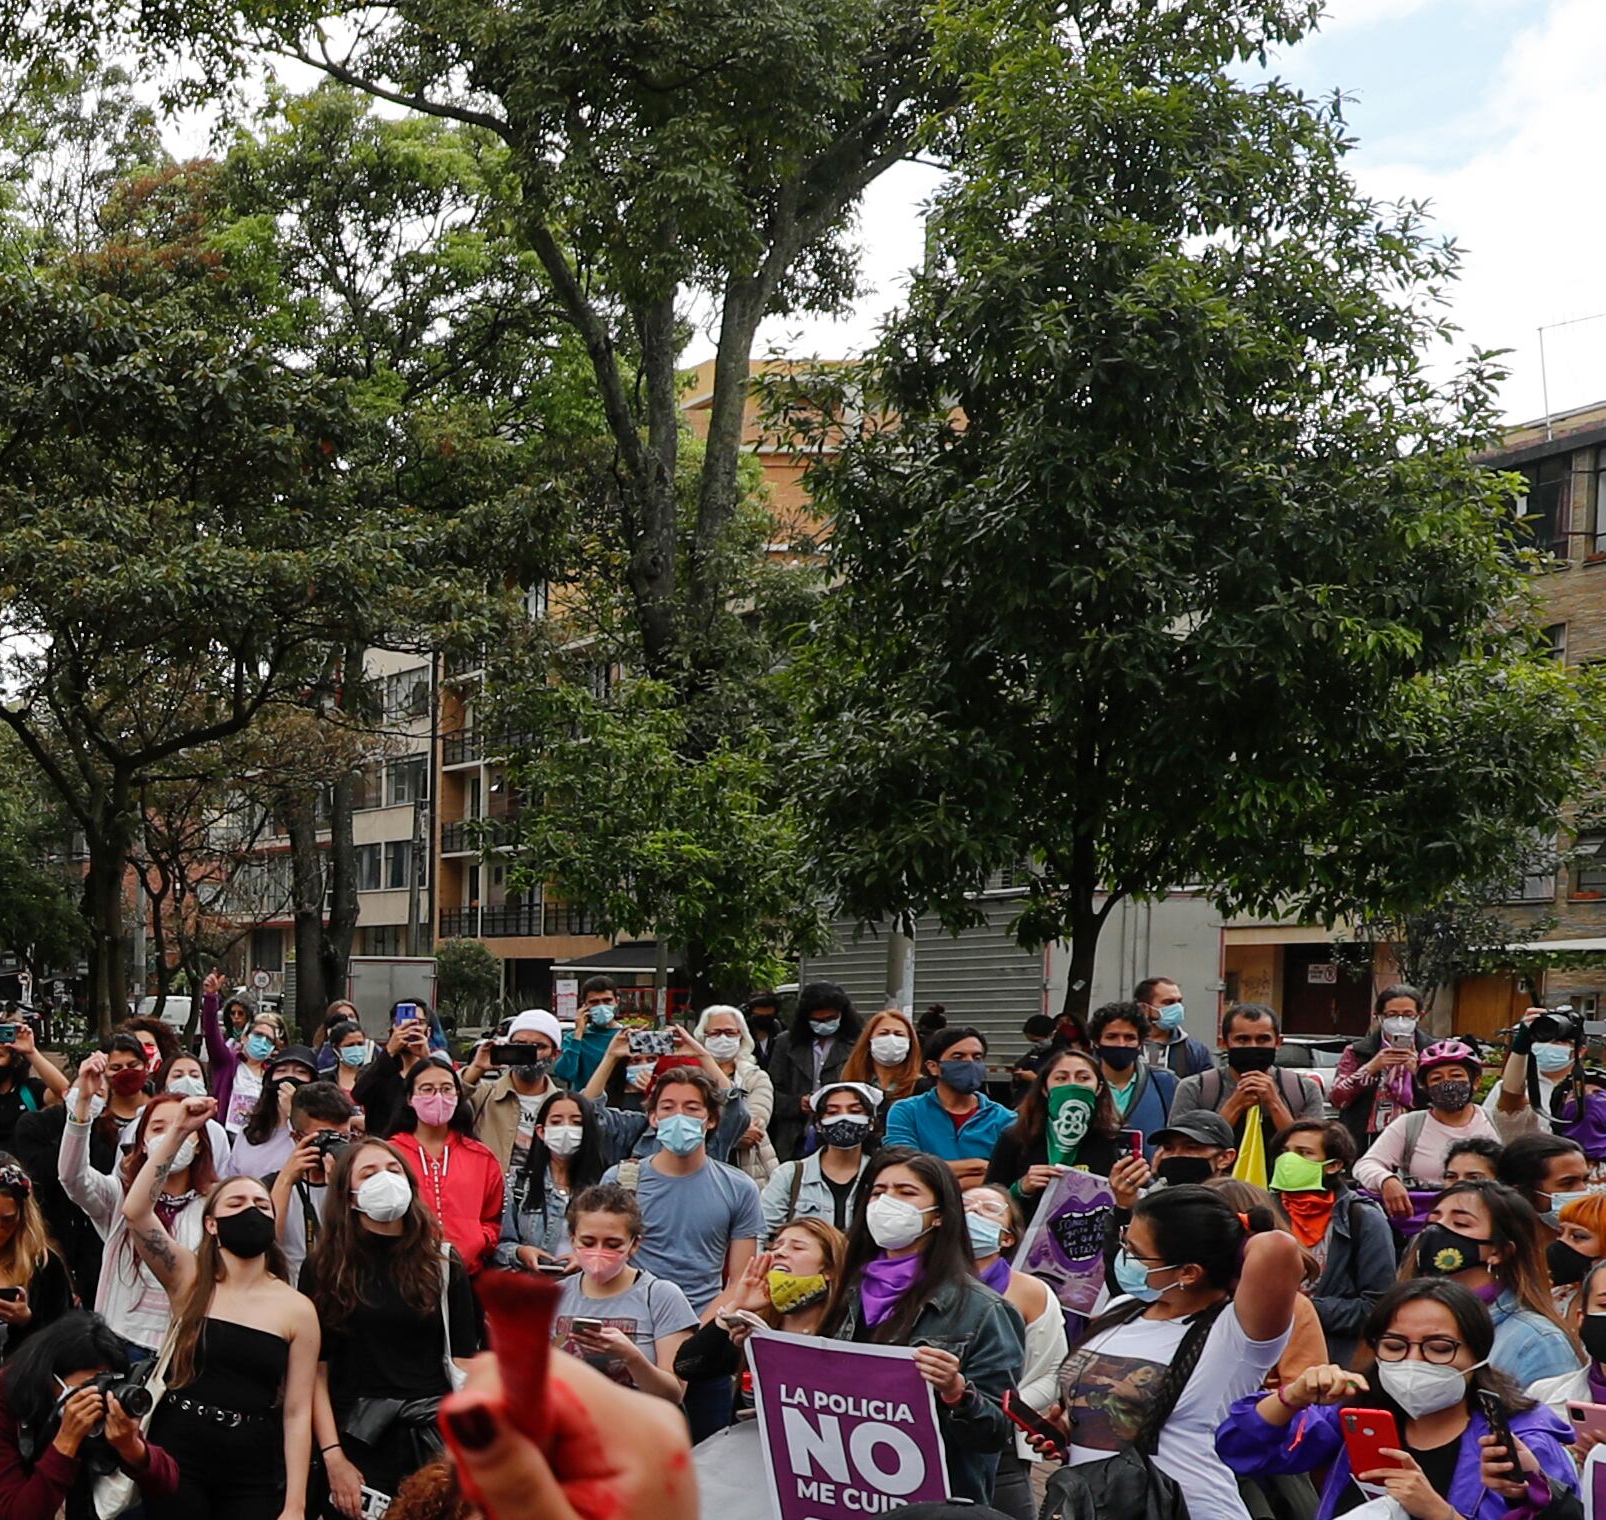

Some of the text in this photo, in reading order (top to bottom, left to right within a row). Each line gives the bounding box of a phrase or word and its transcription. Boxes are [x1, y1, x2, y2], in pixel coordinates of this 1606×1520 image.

[780, 1384, 916, 1424] LA POLICIA
[781, 1405, 926, 1496] NO
[796, 1477, 836, 1505] ME
